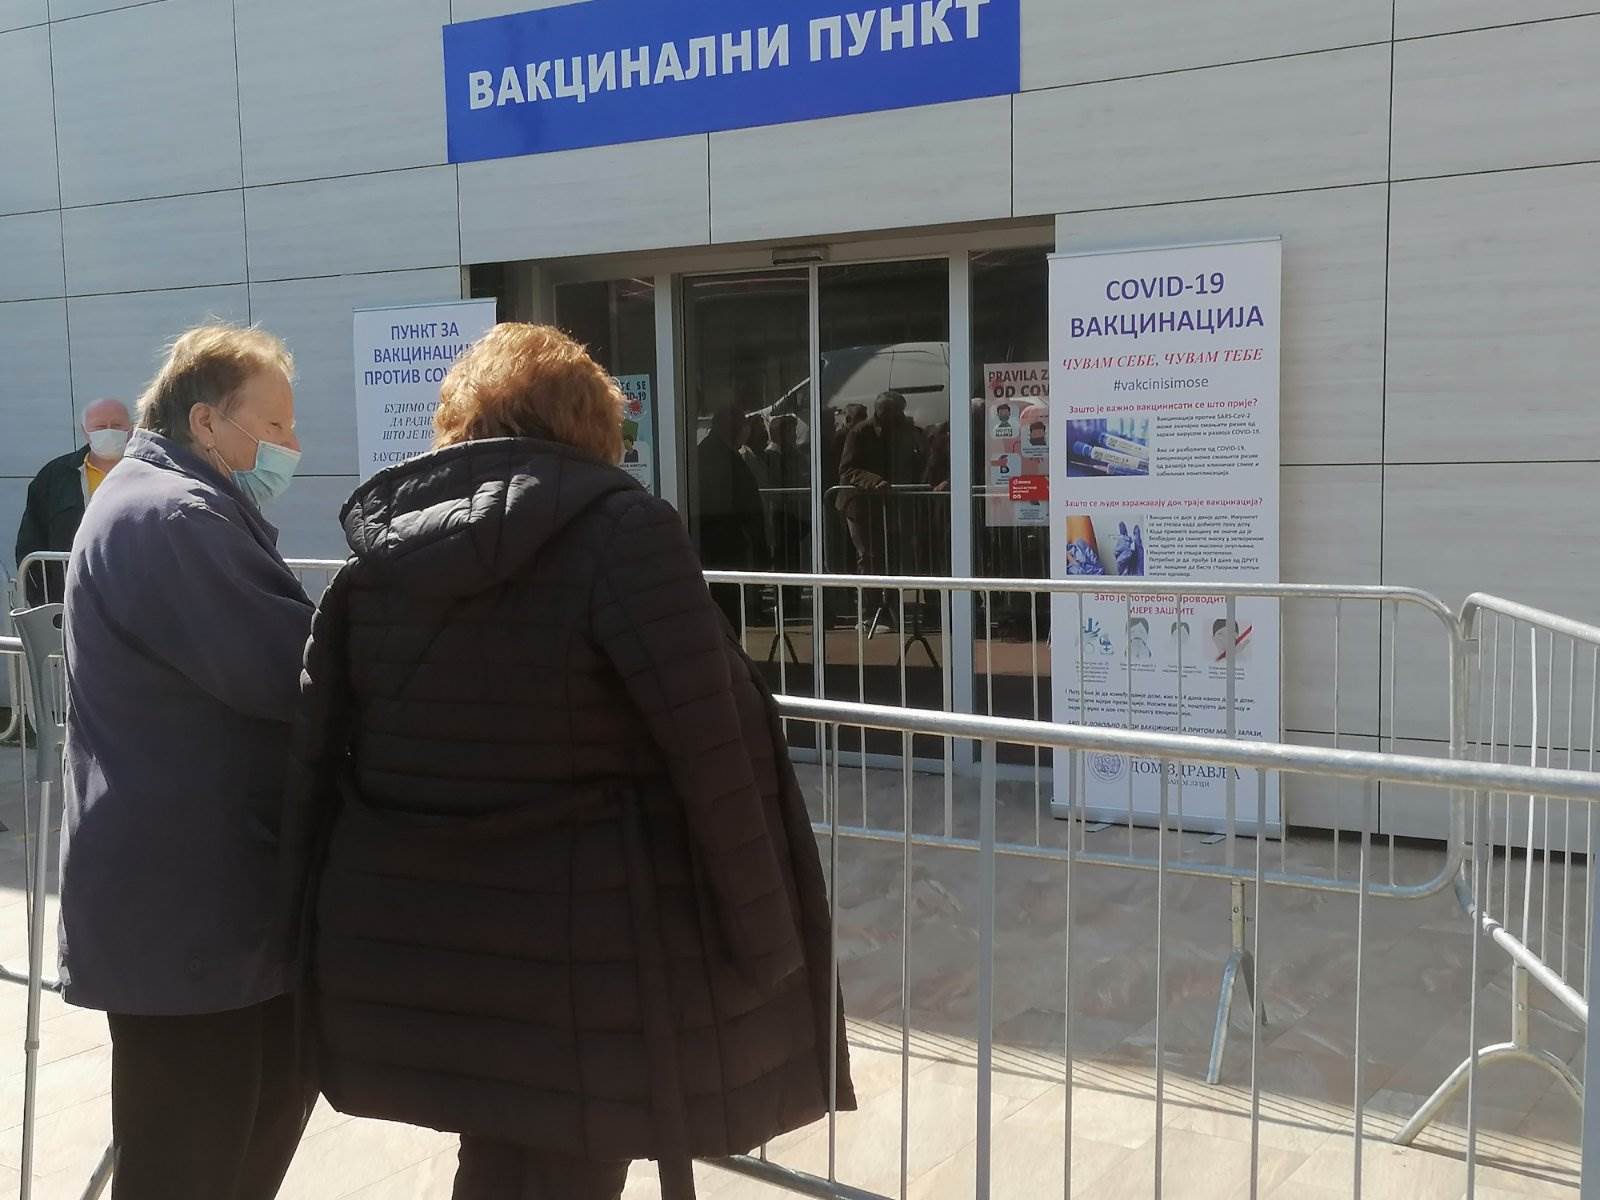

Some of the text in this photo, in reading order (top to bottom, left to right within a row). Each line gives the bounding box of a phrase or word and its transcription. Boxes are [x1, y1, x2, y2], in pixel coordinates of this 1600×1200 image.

[468, 0, 991, 111] ВАКЦИНАЛНИ ПУНКТ
[1106, 272, 1224, 301] COVID-19
[1071, 305, 1264, 339] ВАКЦИНАЦИЈА
[391, 322, 459, 340] ПУНКТ ЗА
[374, 344, 472, 364] ВАКЦИНАЦИ
[1062, 348, 1264, 370] ЧУВАМ СЕБЕ, ЧУВАМ ТЕБЕ
[365, 369, 420, 385] ПРОТИВ
[988, 369, 1038, 383] PRAVILA
[993, 385, 1016, 399] OD
[1113, 377, 1209, 392] #vakcinisimose
[384, 402, 424, 413] БУДИМО
[1069, 398, 1258, 415] Зашто је важно вакцинисати се што прије?
[390, 416, 402, 427] ДА
[383, 430, 405, 440] ШТО
[1094, 592, 1114, 601] Зато
[1179, 594, 1225, 605] роводит
